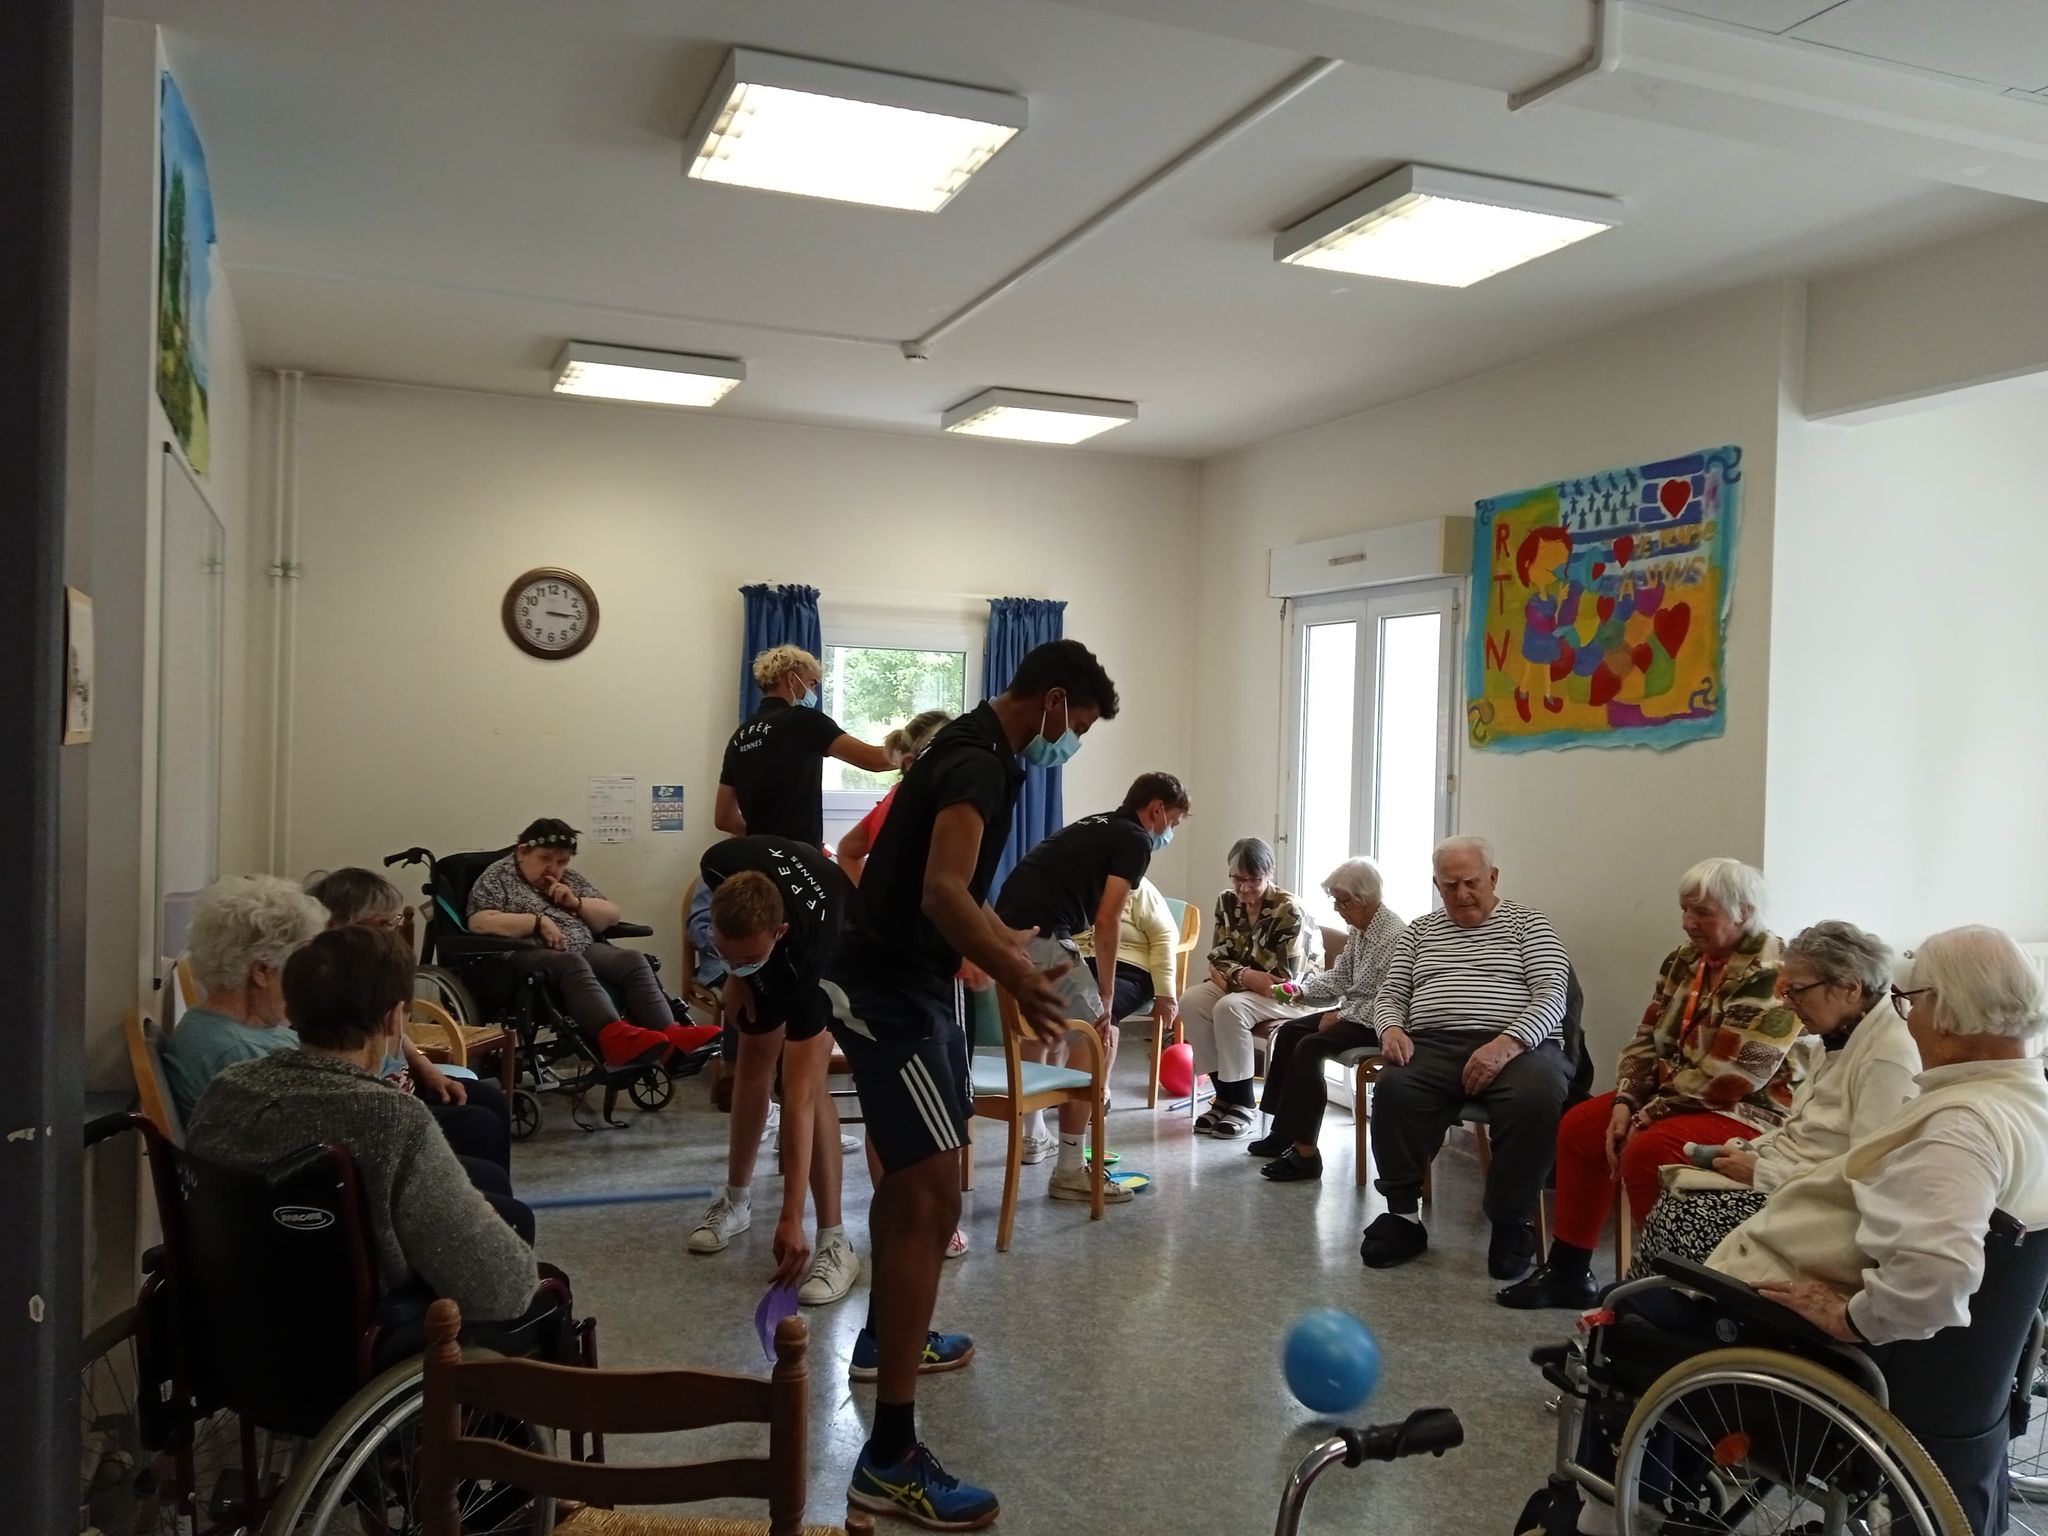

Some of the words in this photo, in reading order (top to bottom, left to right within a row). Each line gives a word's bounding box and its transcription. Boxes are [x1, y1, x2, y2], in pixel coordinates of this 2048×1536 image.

[536, 587, 545, 597] 11
[547, 584, 559, 595] 12
[562, 589, 568, 599] 1
[526, 596, 538, 606] 10
[571, 598, 578, 608] 2
[521, 607, 528, 617] 9
[575, 610, 581, 620] 3
[525, 619, 532, 629] 8
[548, 632, 554, 642] 6
[560, 630, 567, 640] 5
[739, 738, 763, 753] RENNES
[790, 856, 826, 900] RENNES
